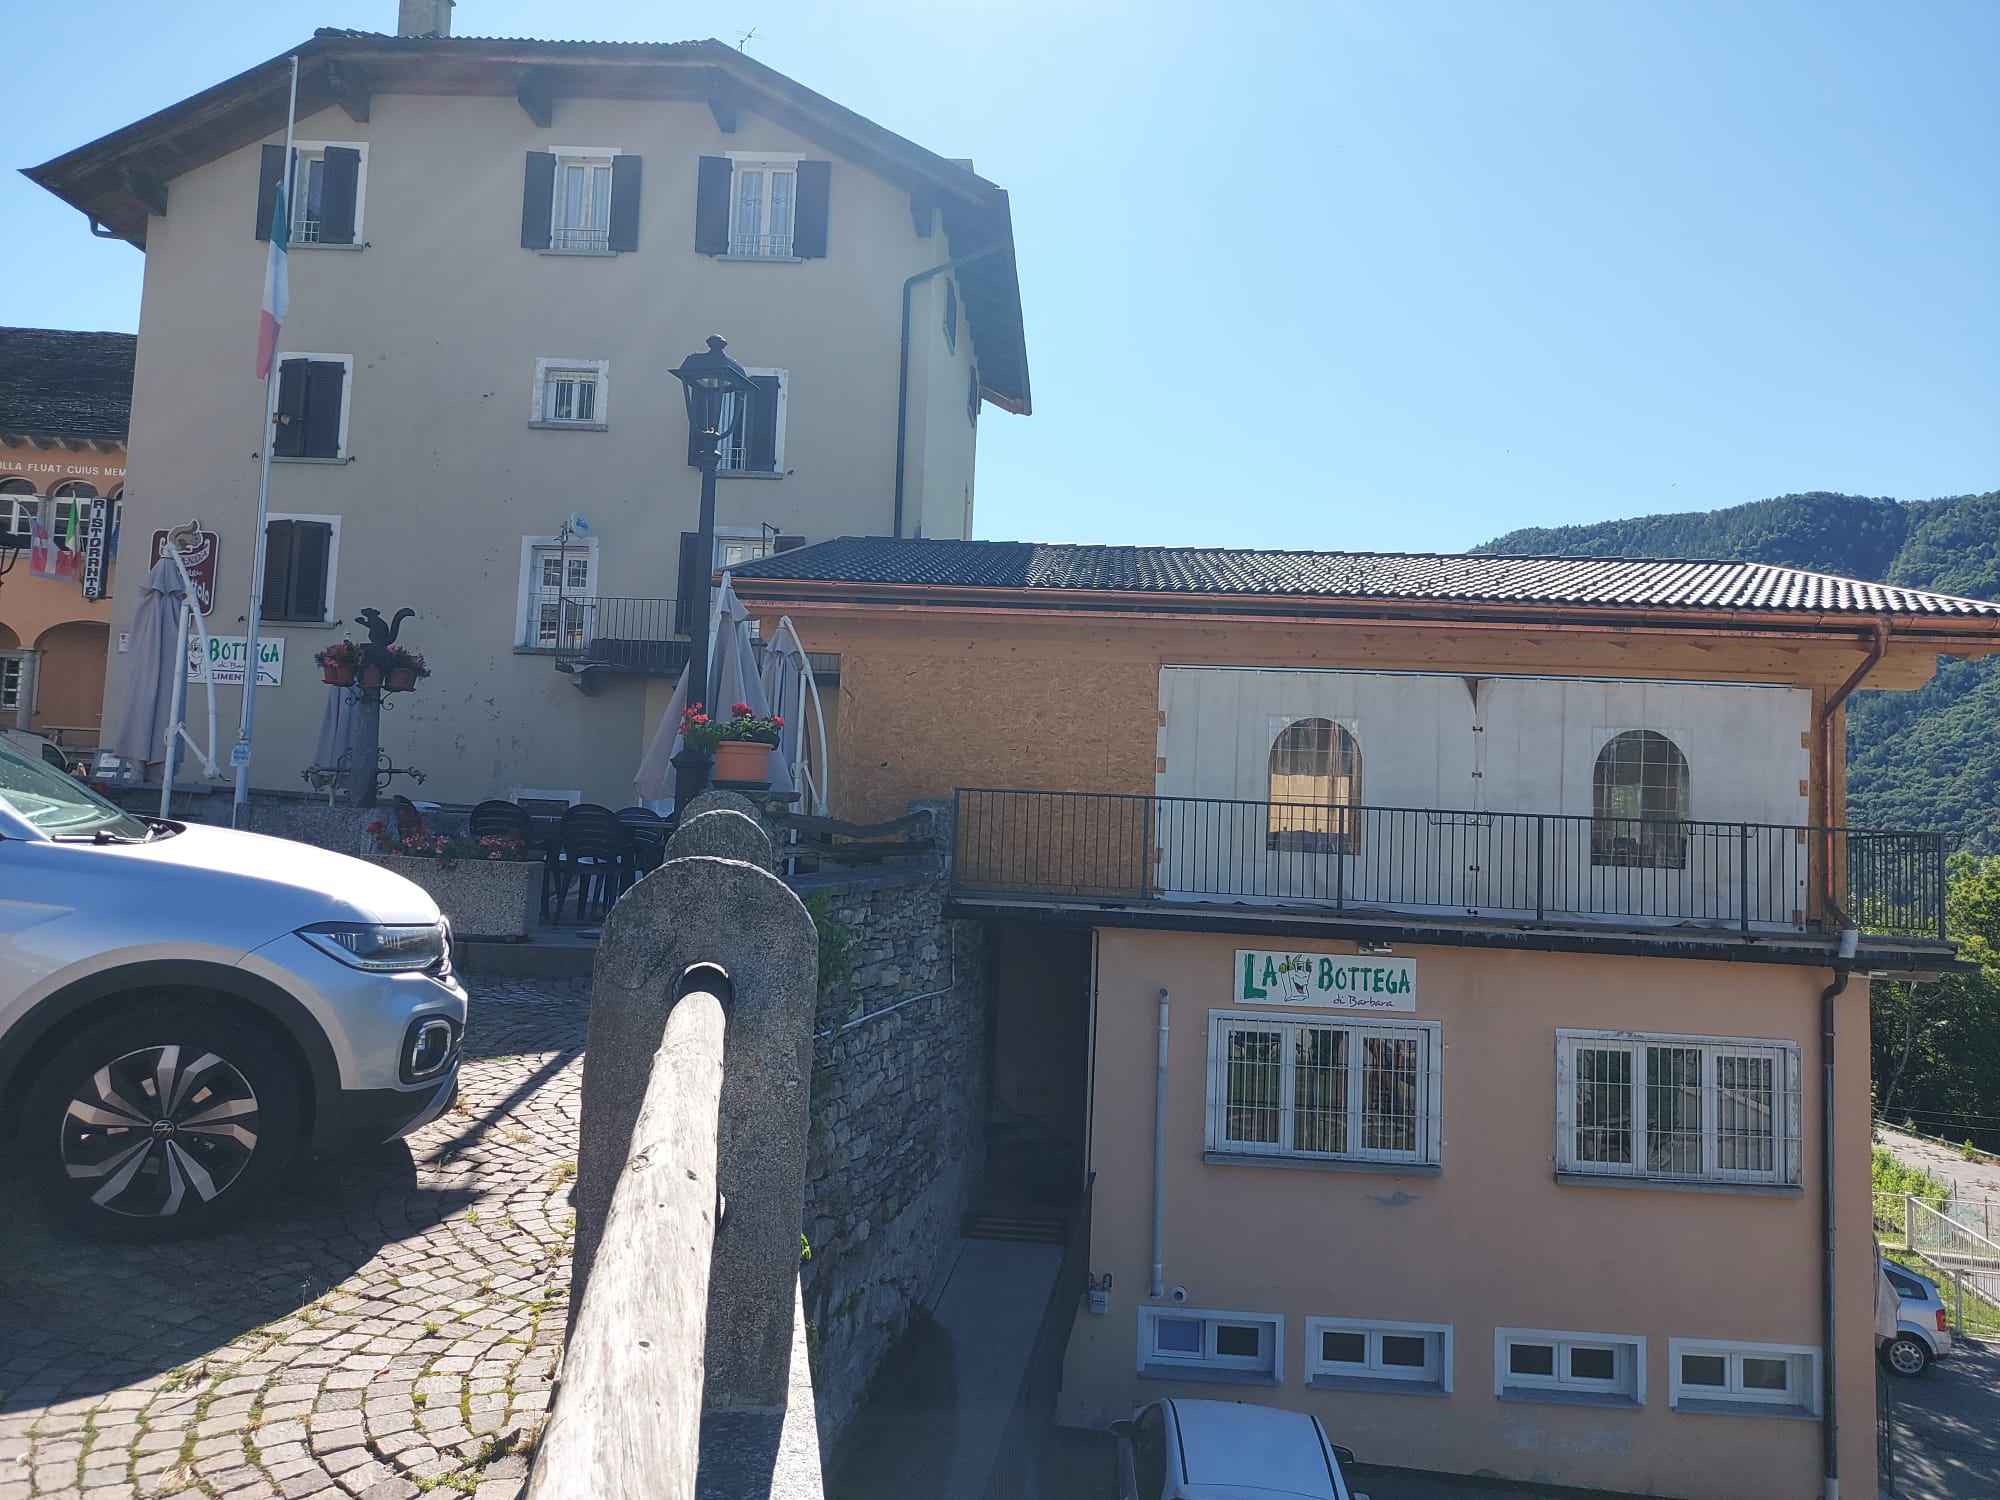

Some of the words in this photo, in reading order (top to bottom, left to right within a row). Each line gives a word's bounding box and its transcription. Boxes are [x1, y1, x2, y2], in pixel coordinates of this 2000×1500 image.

[27, 463, 62, 473] FLUAT
[67, 465, 100, 475] CUIUS
[85, 499, 106, 596] RISTORANTE
[209, 638, 279, 663] BOTTGA
[1243, 953, 1279, 1000] LA
[1317, 957, 1411, 995] BOTTEGA
[1333, 994, 1346, 1005] di
[1348, 995, 1396, 1008] Barbara
